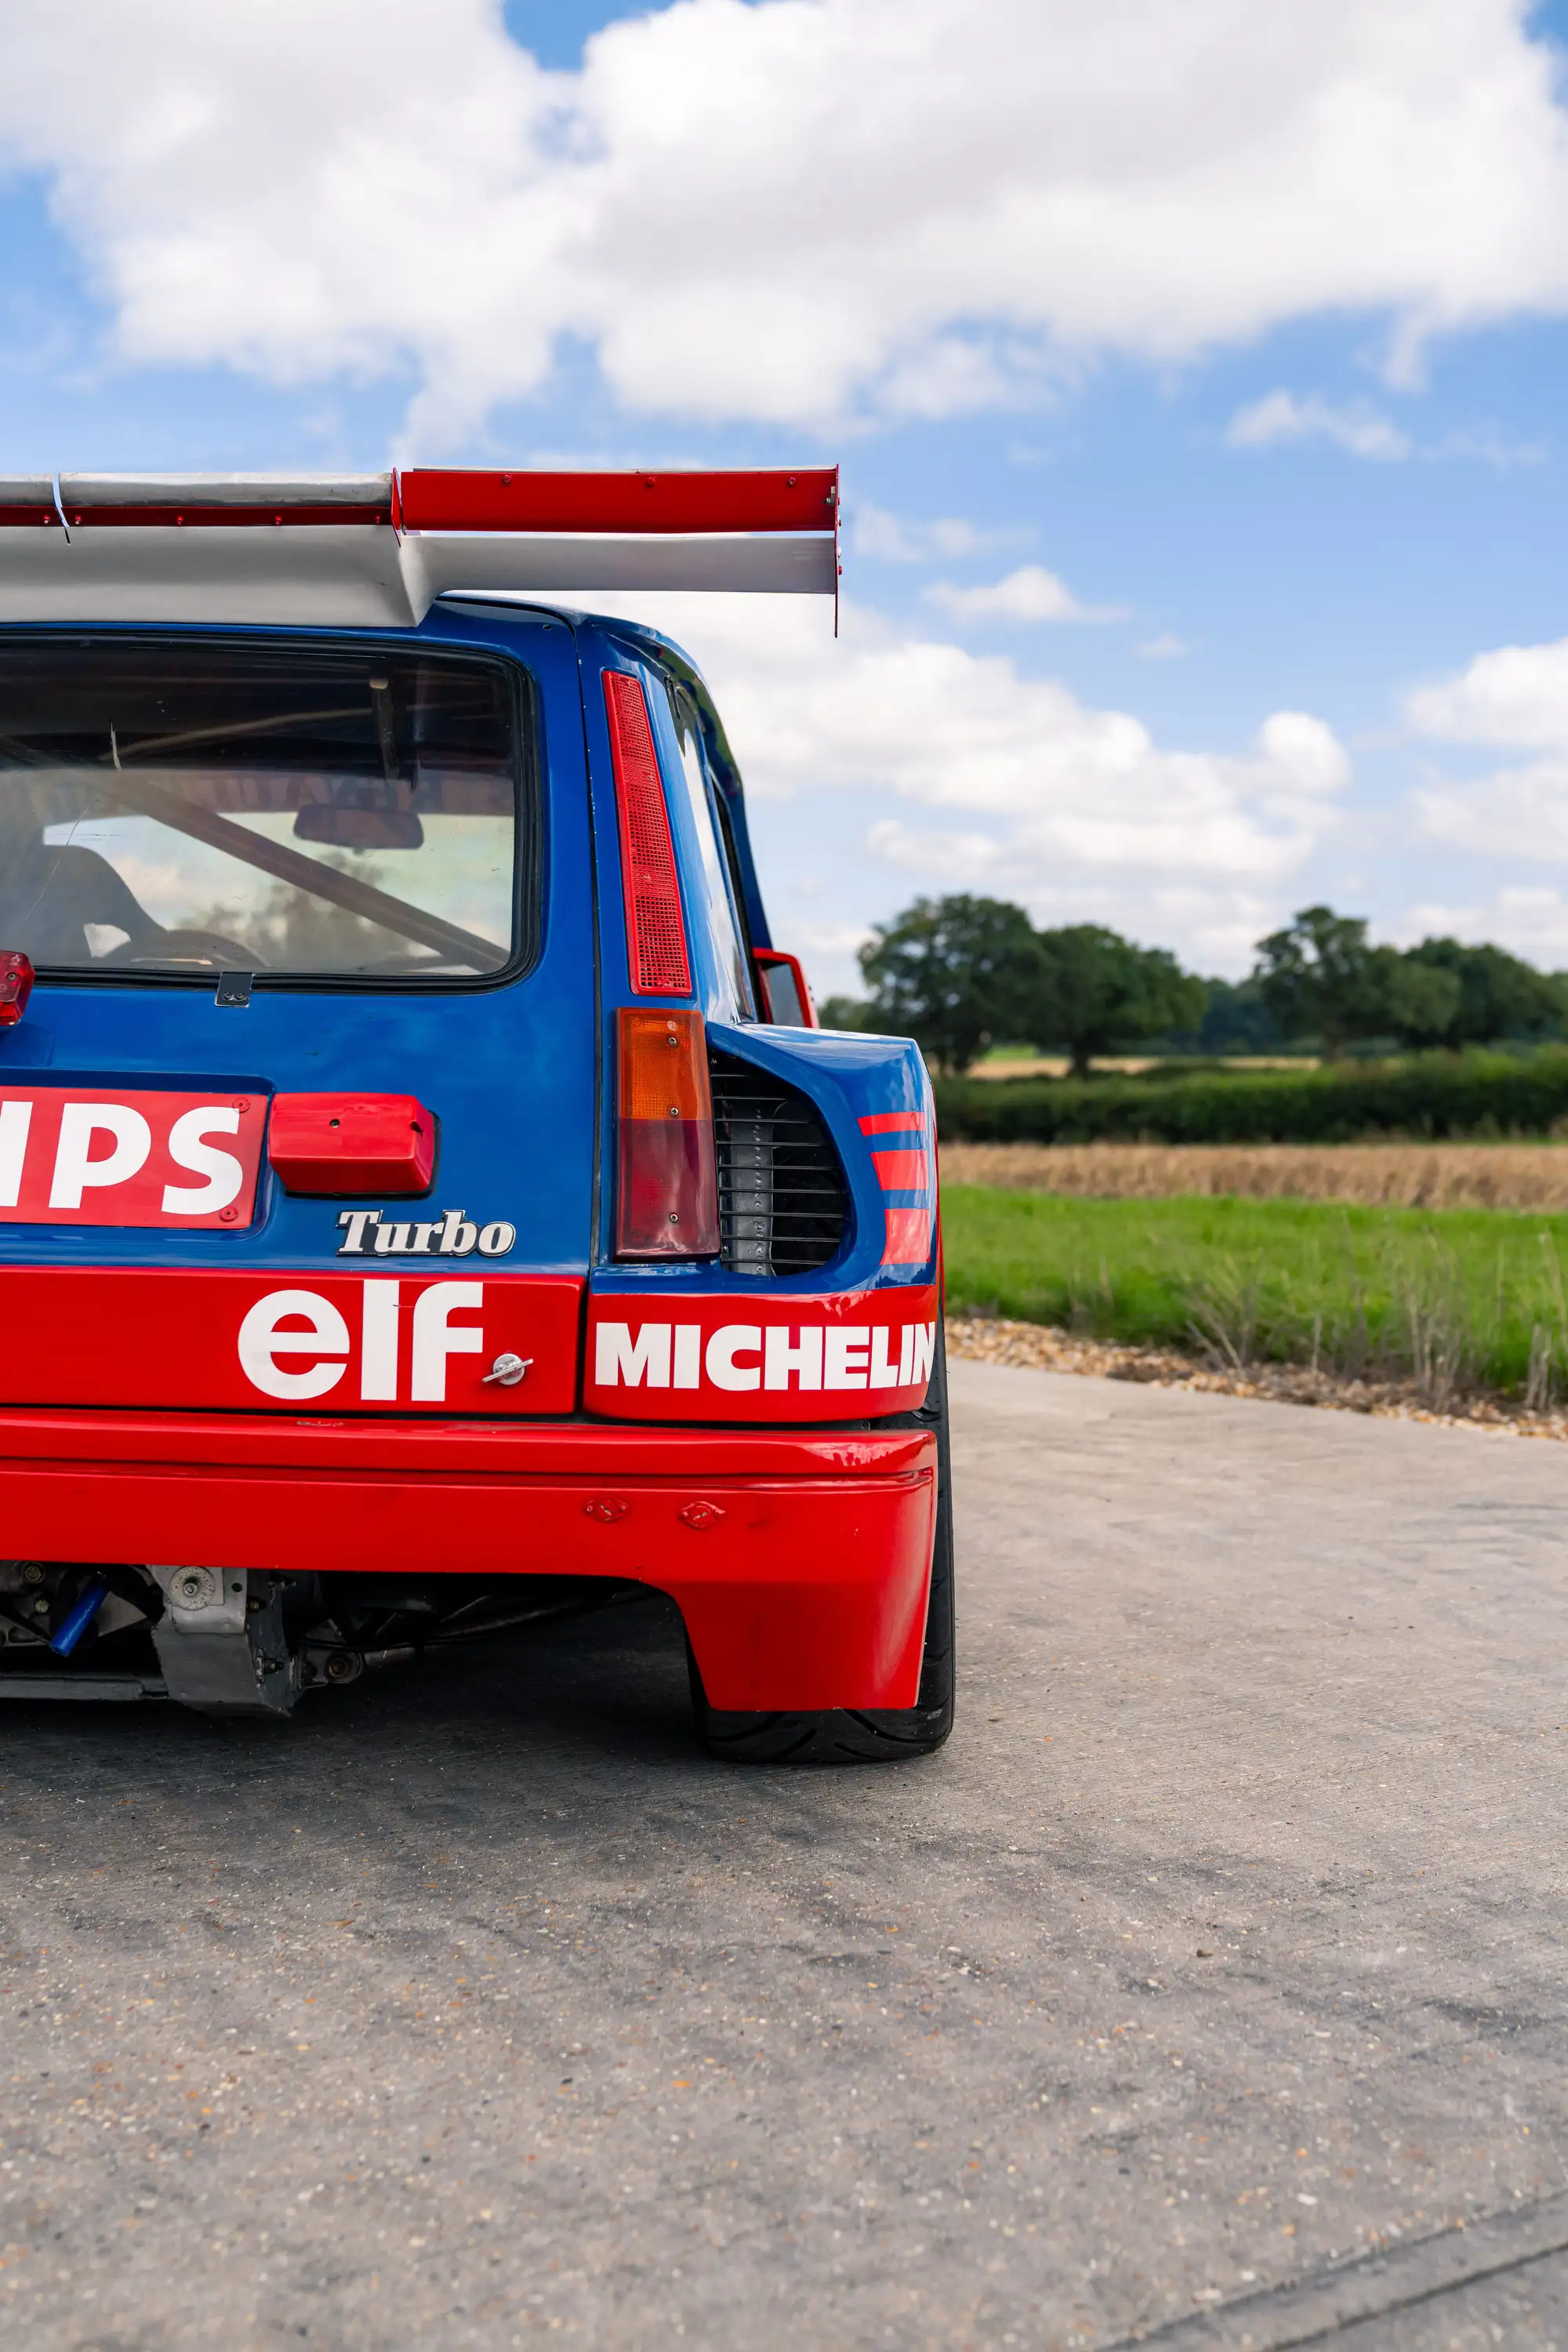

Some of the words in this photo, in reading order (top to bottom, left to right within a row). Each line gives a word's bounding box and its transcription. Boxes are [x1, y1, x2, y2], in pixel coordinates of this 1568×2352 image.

[338, 1210, 514, 1256] Turbo
[238, 1279, 483, 1401] elf
[595, 1321, 935, 1391] MICHELIN
